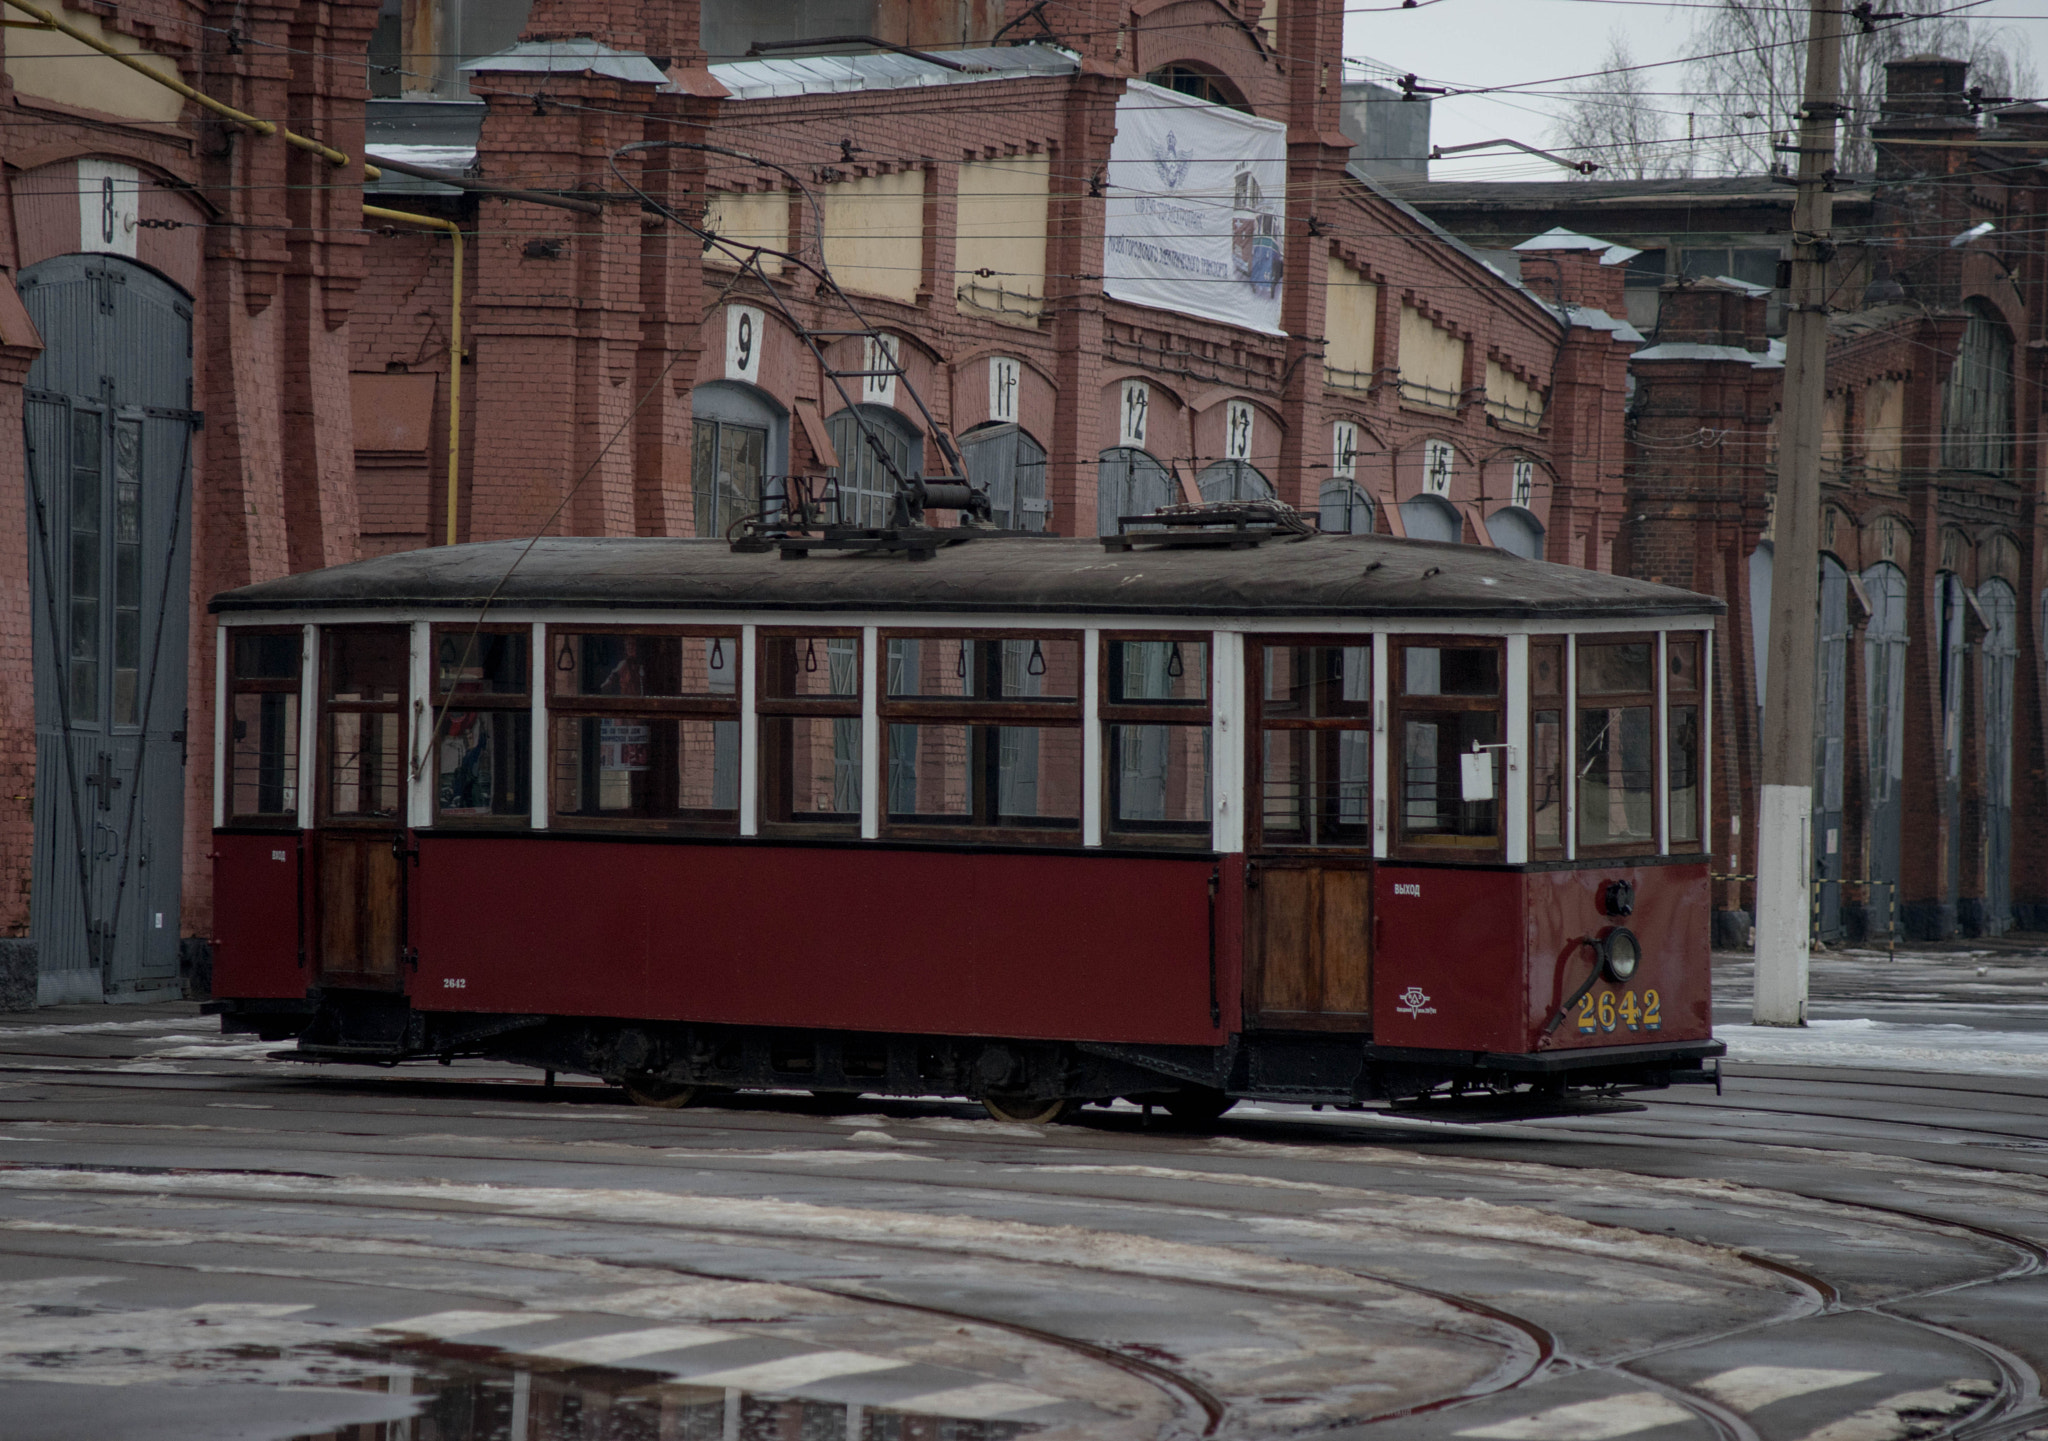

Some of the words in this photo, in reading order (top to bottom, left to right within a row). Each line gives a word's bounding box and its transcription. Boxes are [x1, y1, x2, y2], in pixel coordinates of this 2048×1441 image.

[737, 312, 752, 371] 9
[870, 340, 889, 393] 10
[998, 362, 1011, 417] 11
[1127, 386, 1145, 441] 12
[1231, 406, 1248, 457] 13
[1338, 426, 1352, 474] 14
[1431, 445, 1447, 491] 15
[1516, 461, 1531, 507] 16
[1394, 883, 1421, 898] ВЫХОД
[443, 978, 467, 990] 2642
[1579, 989, 1661, 1033] 2642
